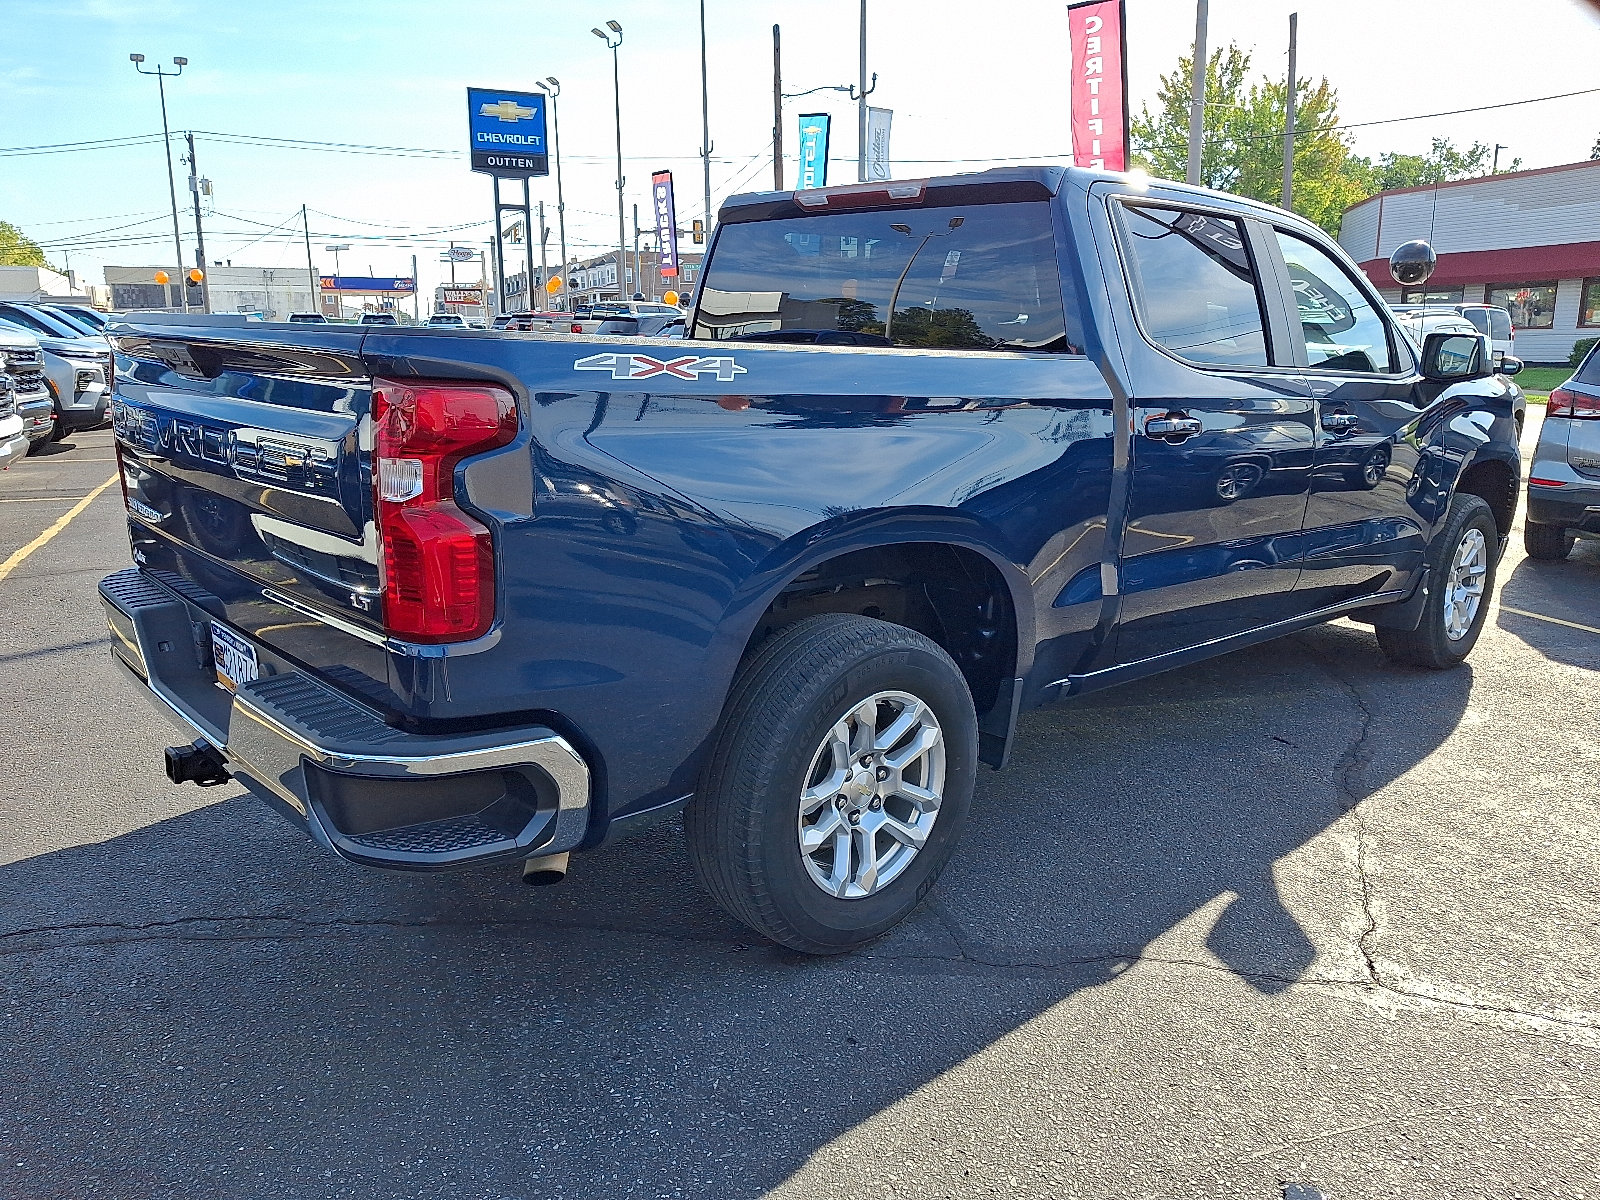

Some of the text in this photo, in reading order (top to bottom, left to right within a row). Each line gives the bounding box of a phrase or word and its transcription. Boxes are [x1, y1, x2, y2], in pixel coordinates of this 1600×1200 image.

[477, 132, 541, 145] CHEVROLET
[487, 156, 533, 168] OUTTEN
[113, 402, 328, 487] CHEVROLET
[350, 593, 371, 611] LT
